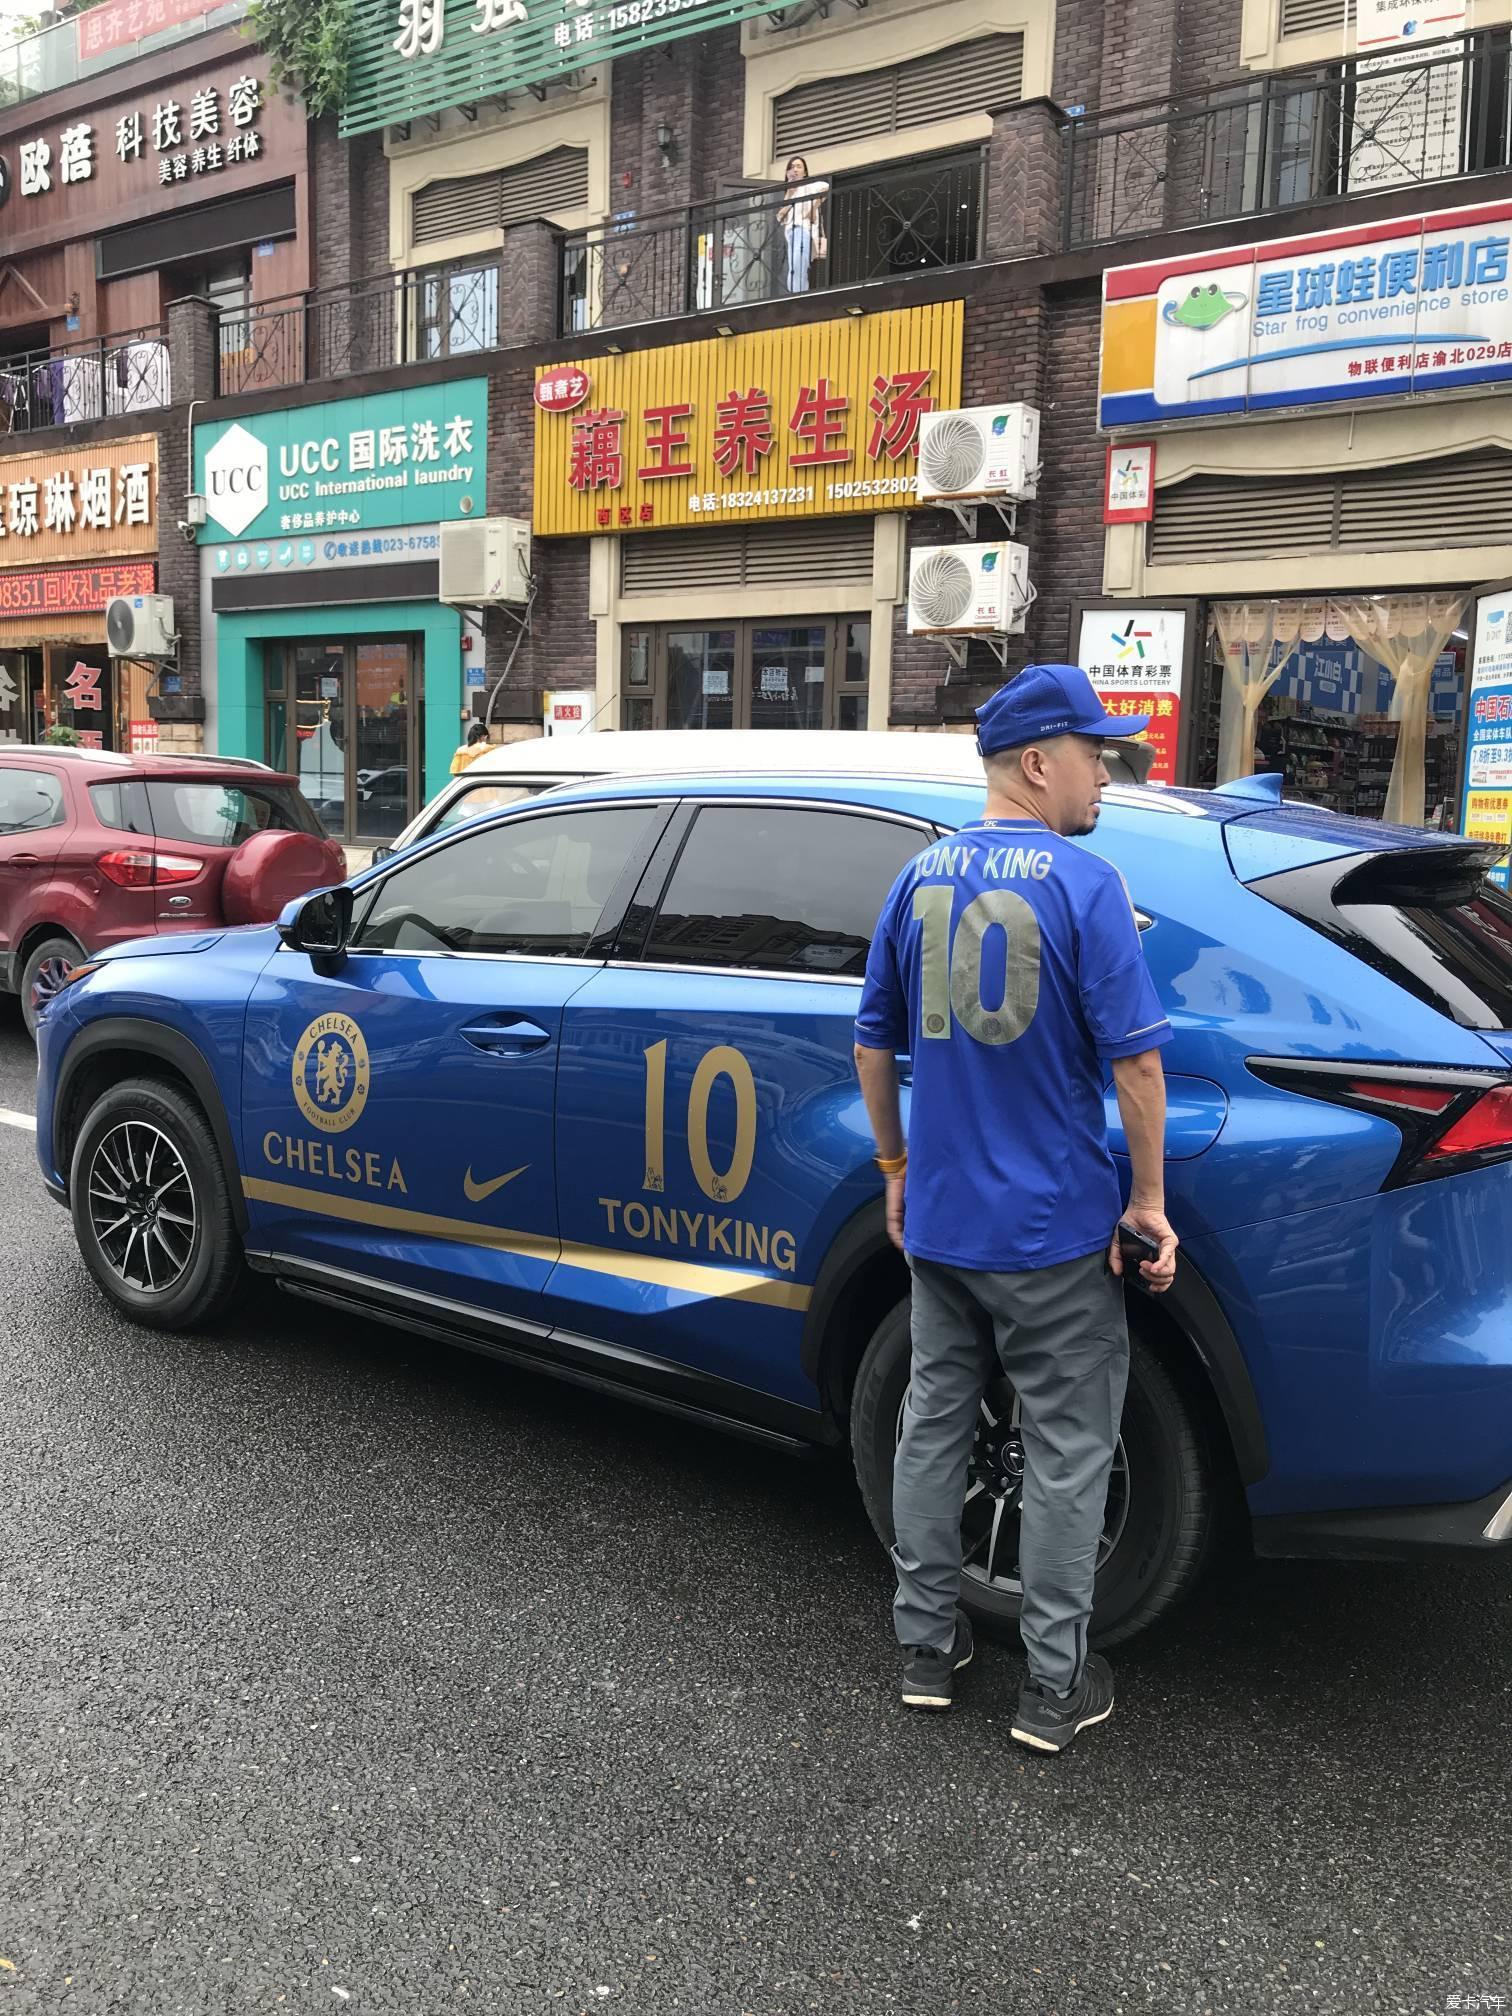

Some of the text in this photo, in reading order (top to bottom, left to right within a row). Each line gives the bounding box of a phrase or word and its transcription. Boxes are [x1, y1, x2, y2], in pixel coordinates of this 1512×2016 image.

[19, 76, 260, 196] 欧蓓 科技美容
[159, 131, 259, 184] 美容 养生 纤体
[1256, 236, 1511, 317] 星球蛙便利店
[1253, 287, 1509, 337] Star frog convenience store
[1348, 341, 1512, 376] 物联便利店渝北029店
[280, 415, 473, 477] UCC 国际洗衣
[568, 369, 936, 491] 藕王养生汤
[0, 462, 151, 537] 琼琳烟酒
[212, 465, 262, 496] UCC
[279, 464, 473, 501] UCC International laundry
[827, 477, 918, 499] 1502532802
[0, 569, 154, 608] 8351回收礼品老酒
[1089, 664, 1172, 678] 中国体育彩票
[1040, 721, 1068, 731] DRI-FIT
[1103, 699, 1173, 717] 大好消费
[1475, 695, 1512, 722] 中国石
[914, 846, 1053, 880] TONY KING
[912, 885, 1041, 1046] 10
[309, 1017, 359, 1044] CHELSEA
[303, 1101, 337, 1127] FOOTBALL
[642, 1038, 757, 1203] 10
[263, 1131, 408, 1193] CHELSEA
[598, 1197, 796, 1272] TONYKING
